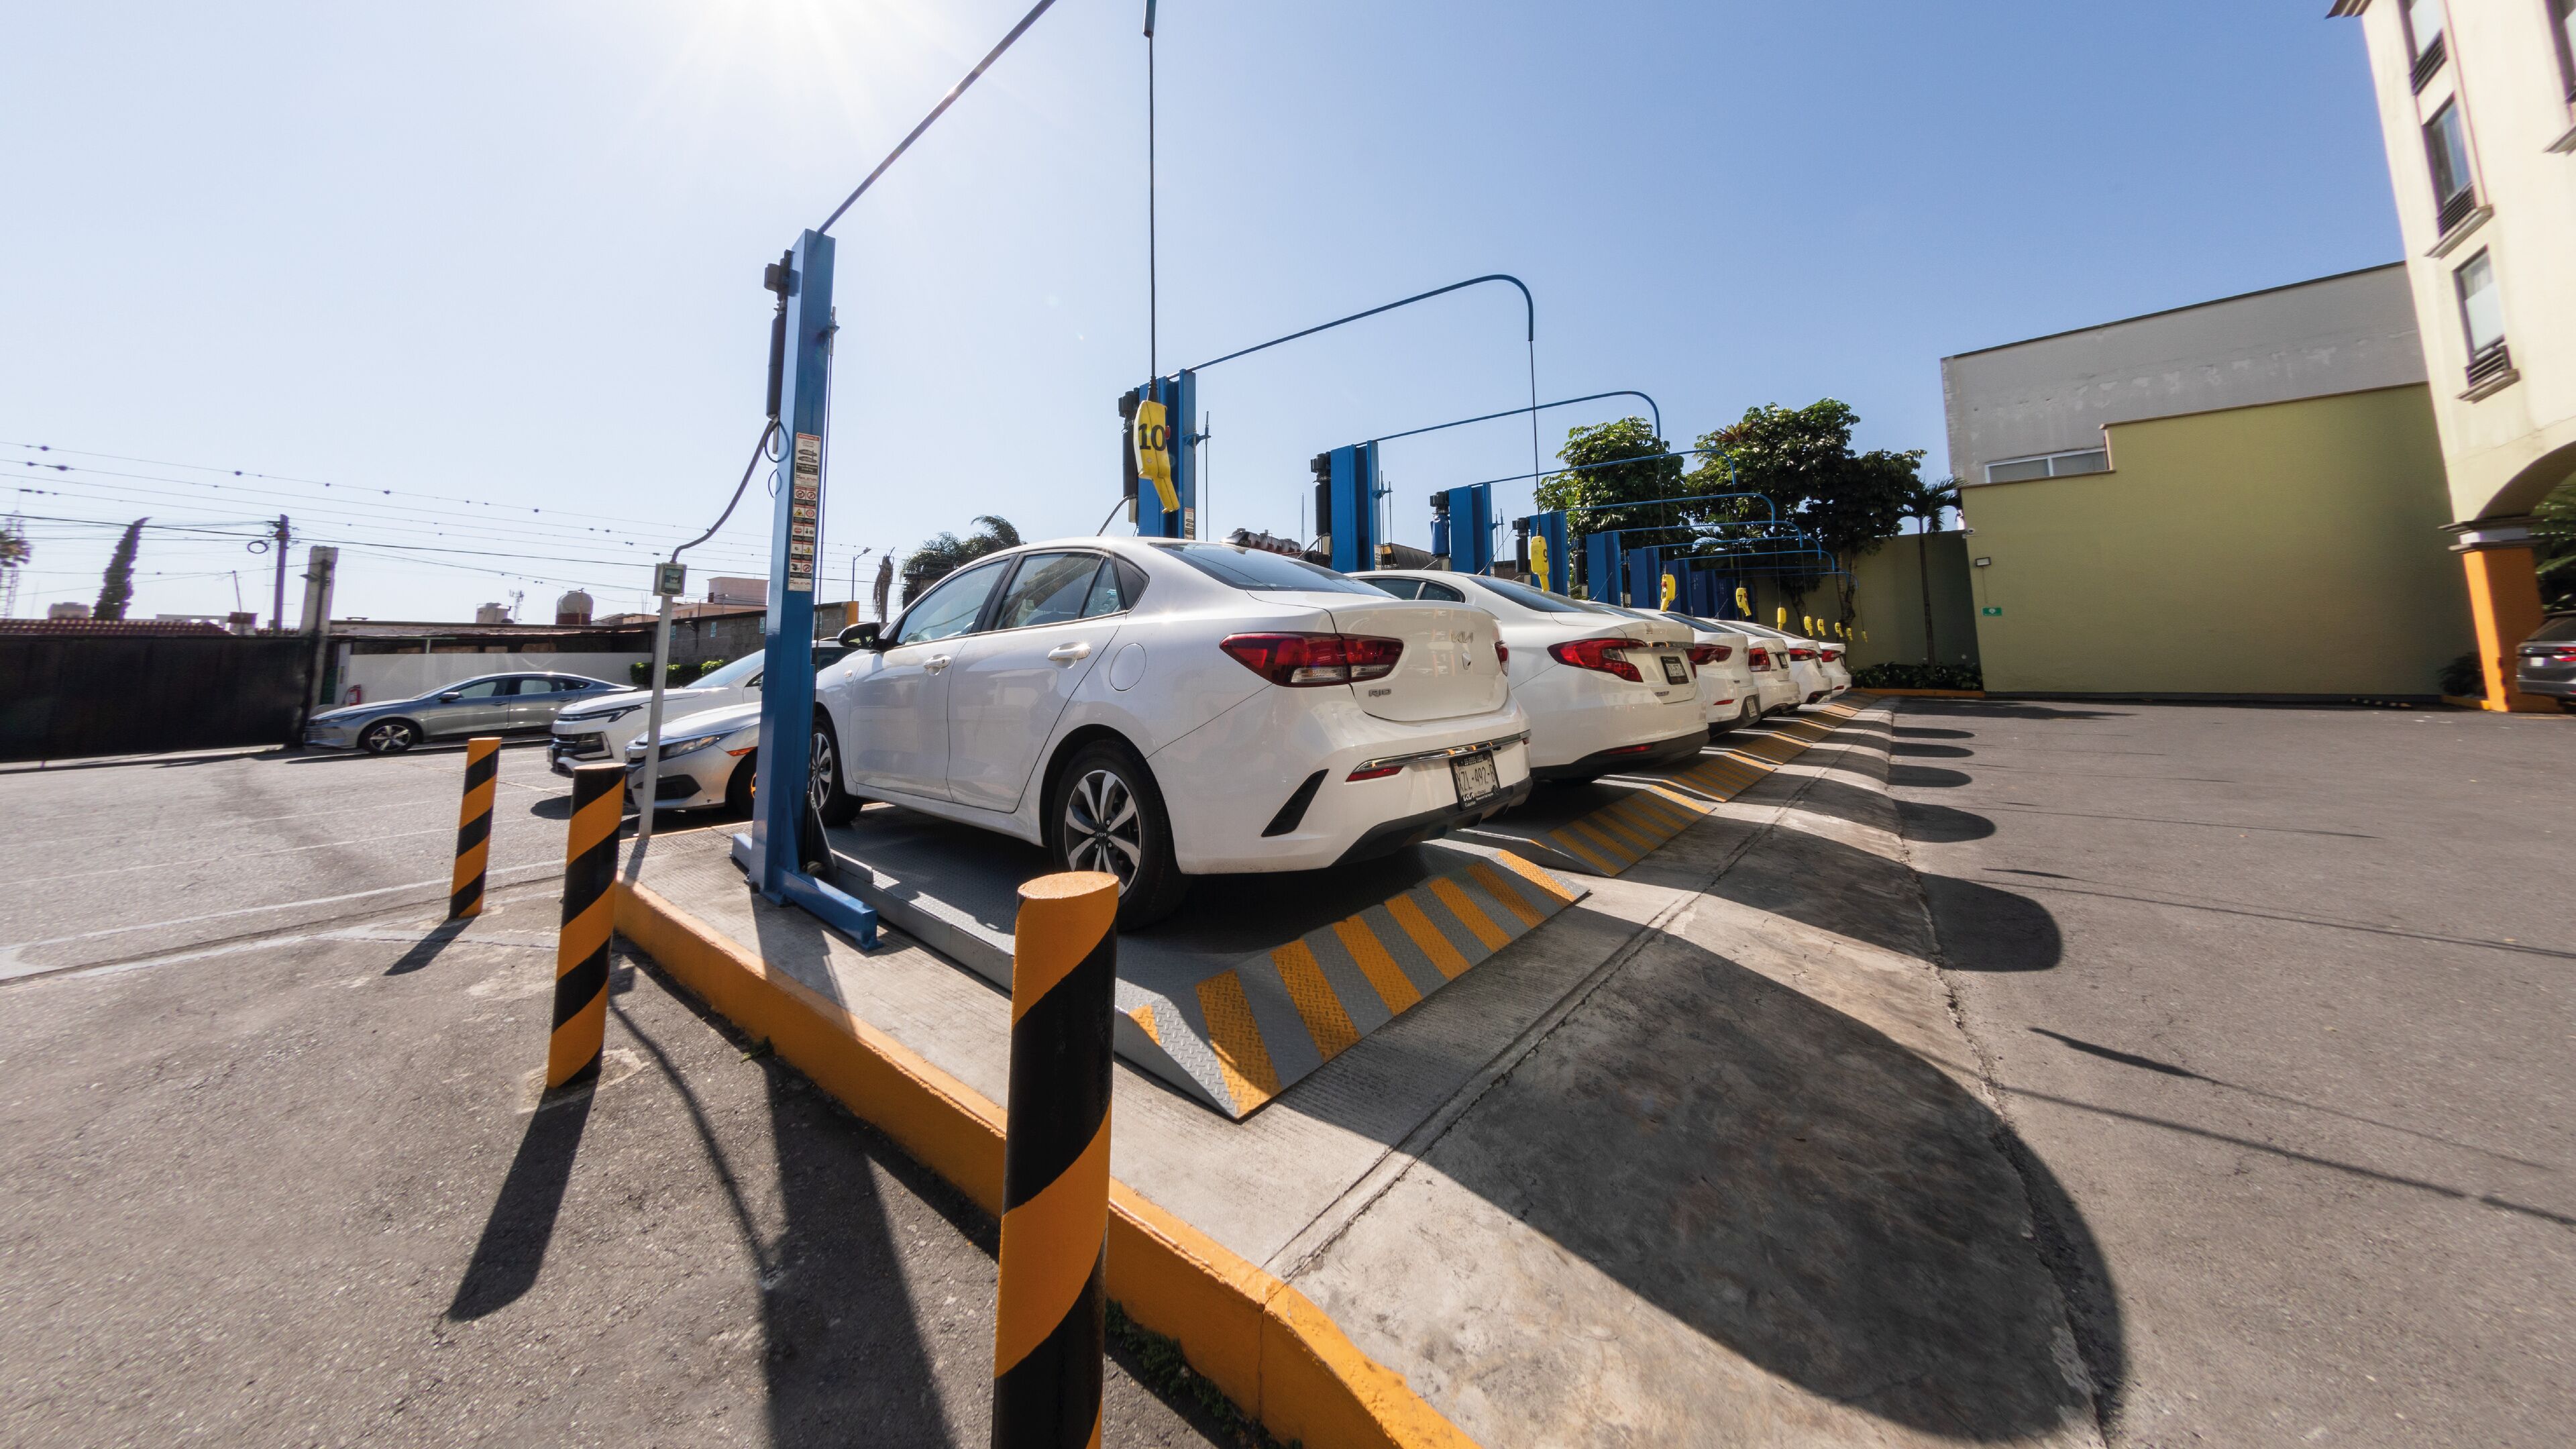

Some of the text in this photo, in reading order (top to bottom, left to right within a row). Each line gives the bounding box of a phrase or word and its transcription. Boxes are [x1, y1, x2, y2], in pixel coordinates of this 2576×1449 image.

[1138, 423, 1167, 451] 10
[1543, 549, 1548, 563] 9
[1737, 594, 1743, 602] 7
[1451, 631, 1474, 643] KIA
[1368, 688, 1391, 697] RIO
[1463, 792, 1474, 802] KIA
